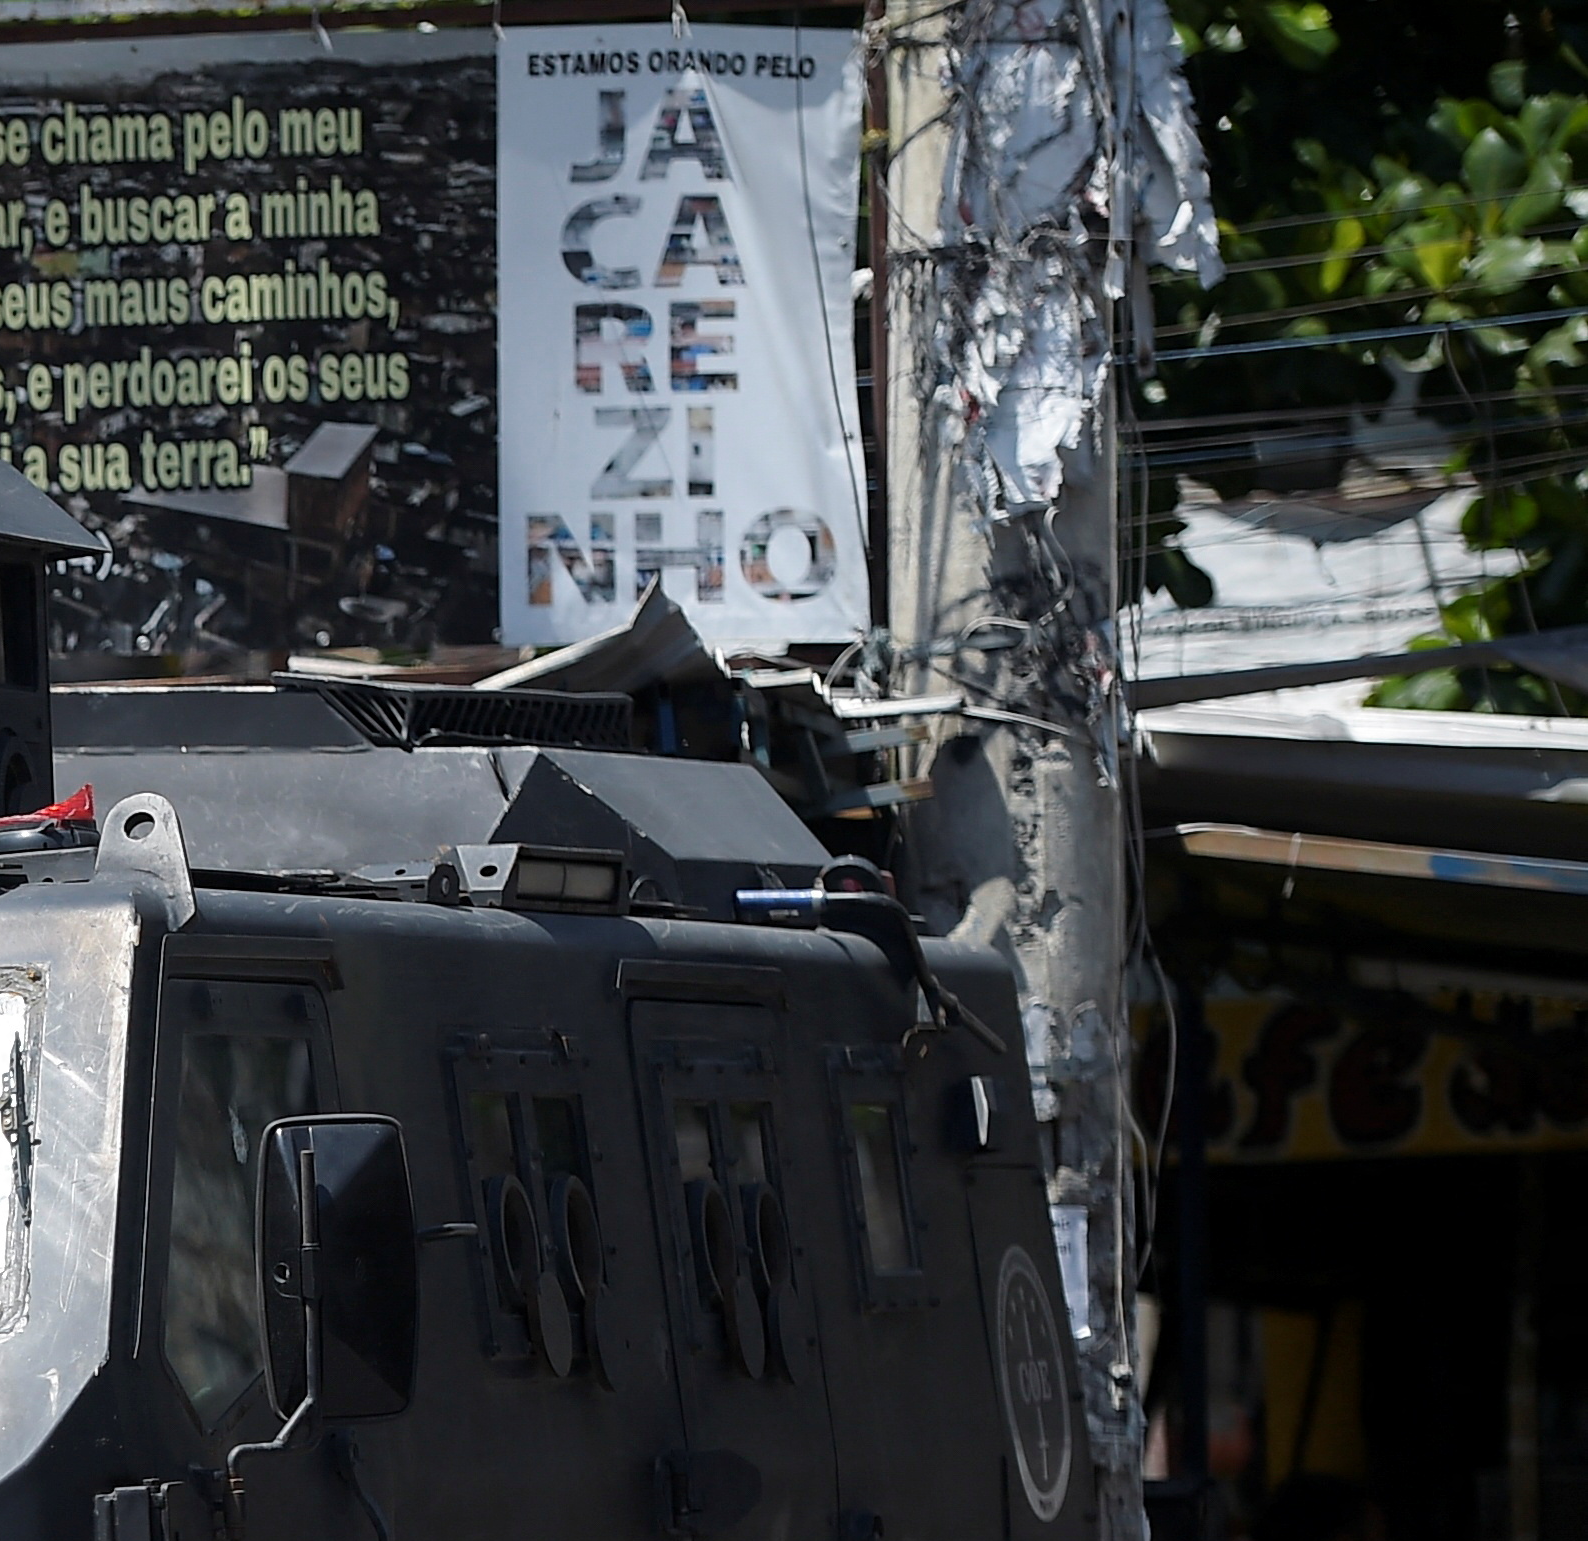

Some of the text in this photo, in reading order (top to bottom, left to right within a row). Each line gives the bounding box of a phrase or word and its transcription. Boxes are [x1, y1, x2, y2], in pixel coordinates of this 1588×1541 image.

[529, 49, 816, 78] ESTAMOS ORANDO PELO
[41, 102, 174, 164] chama
[184, 95, 269, 174] pelo
[280, 107, 362, 155] meu
[44, 200, 70, 245] e
[80, 183, 216, 244] buscar
[225, 192, 253, 241] a
[262, 175, 380, 239] minha
[84, 276, 191, 327] maus
[201, 257, 400, 330] caminhos,
[27, 362, 53, 412] e
[63, 341, 253, 425] perdoarei
[262, 353, 309, 403] os
[319, 352, 410, 402] seus
[58, 441, 132, 493] sua
